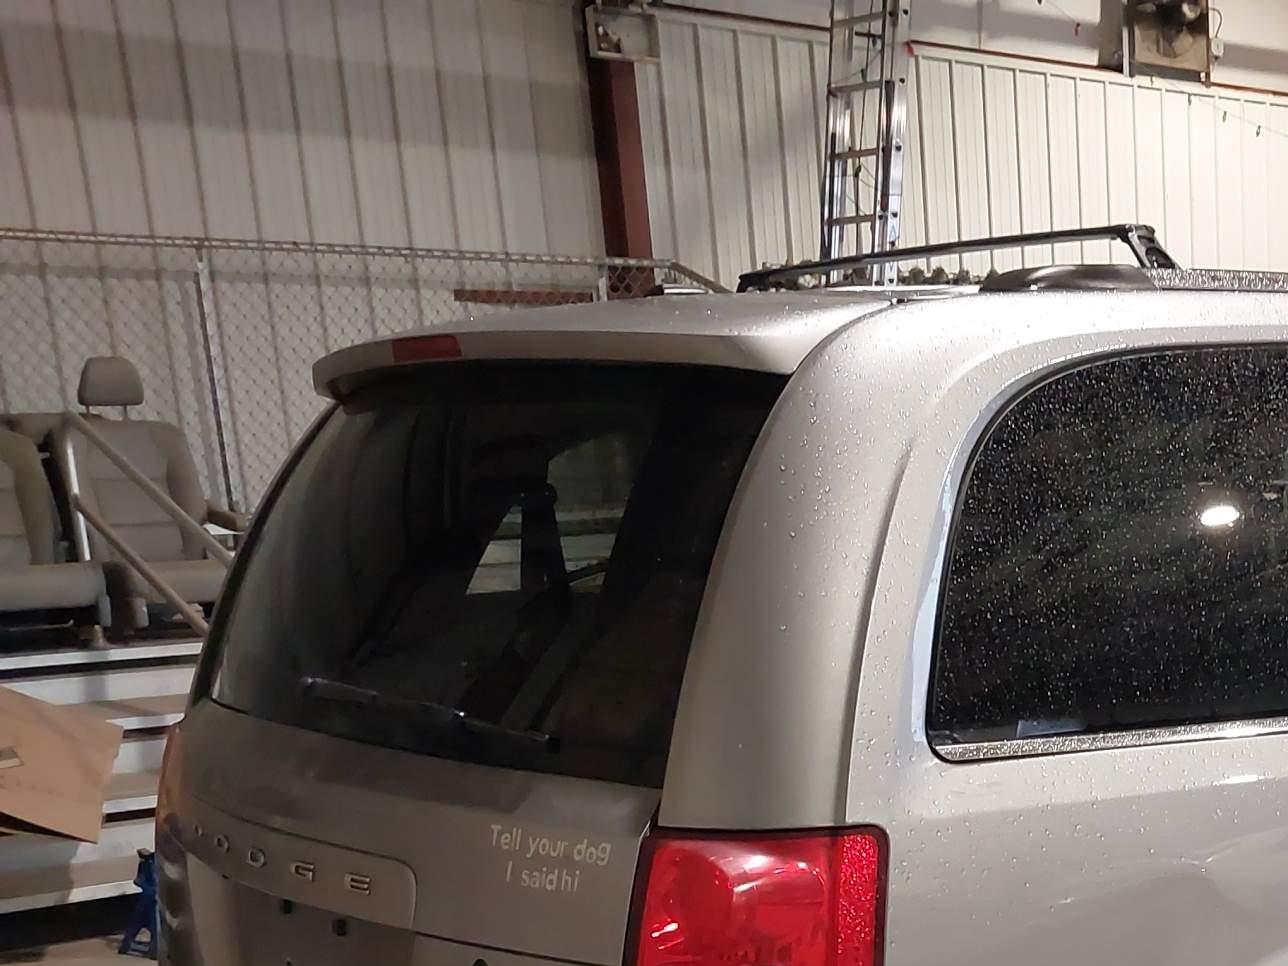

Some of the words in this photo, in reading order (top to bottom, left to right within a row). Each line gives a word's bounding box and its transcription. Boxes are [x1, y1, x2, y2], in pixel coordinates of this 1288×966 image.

[490, 824, 521, 850] Tell
[526, 836, 568, 859] your
[573, 839, 611, 865] dog
[506, 860, 513, 882] I
